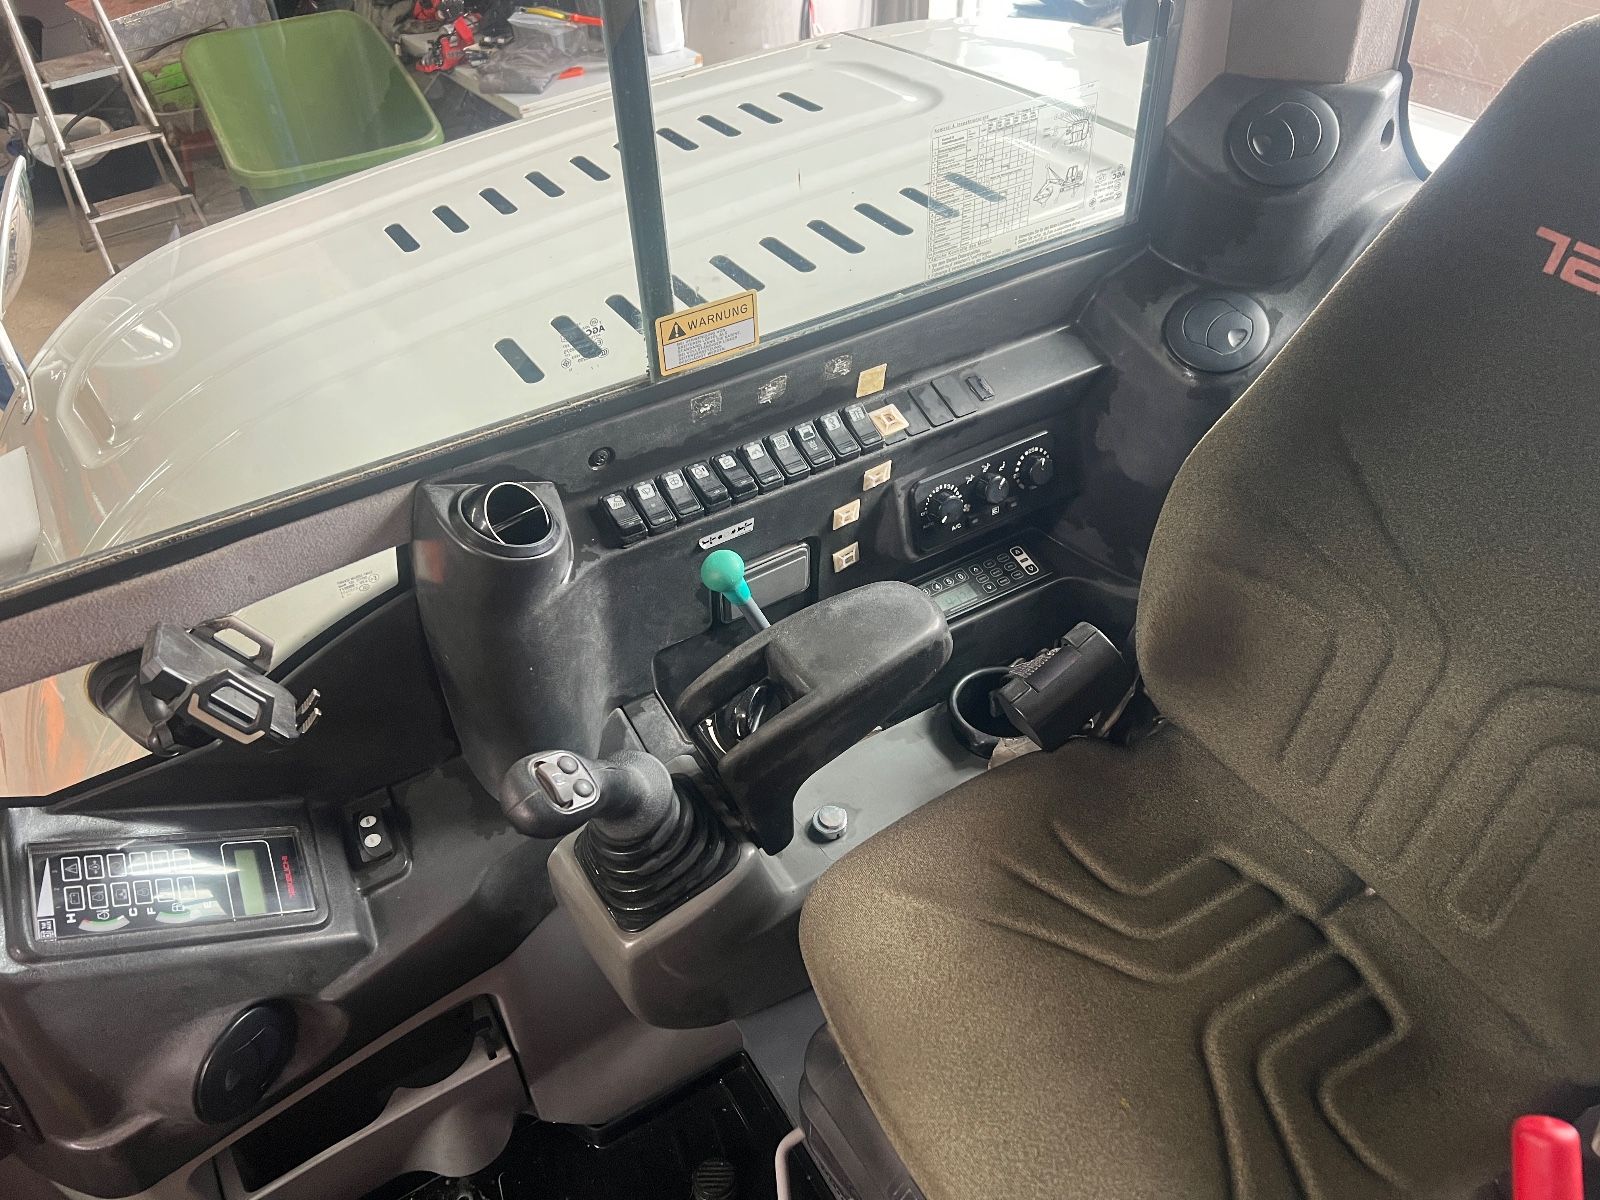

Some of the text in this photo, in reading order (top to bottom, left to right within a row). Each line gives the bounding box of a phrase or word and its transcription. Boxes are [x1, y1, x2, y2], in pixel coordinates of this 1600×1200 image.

[687, 304, 748, 330] WARNUNG
[951, 523, 962, 531] A/C
[128, 907, 138, 917] C
[146, 907, 157, 915] F
